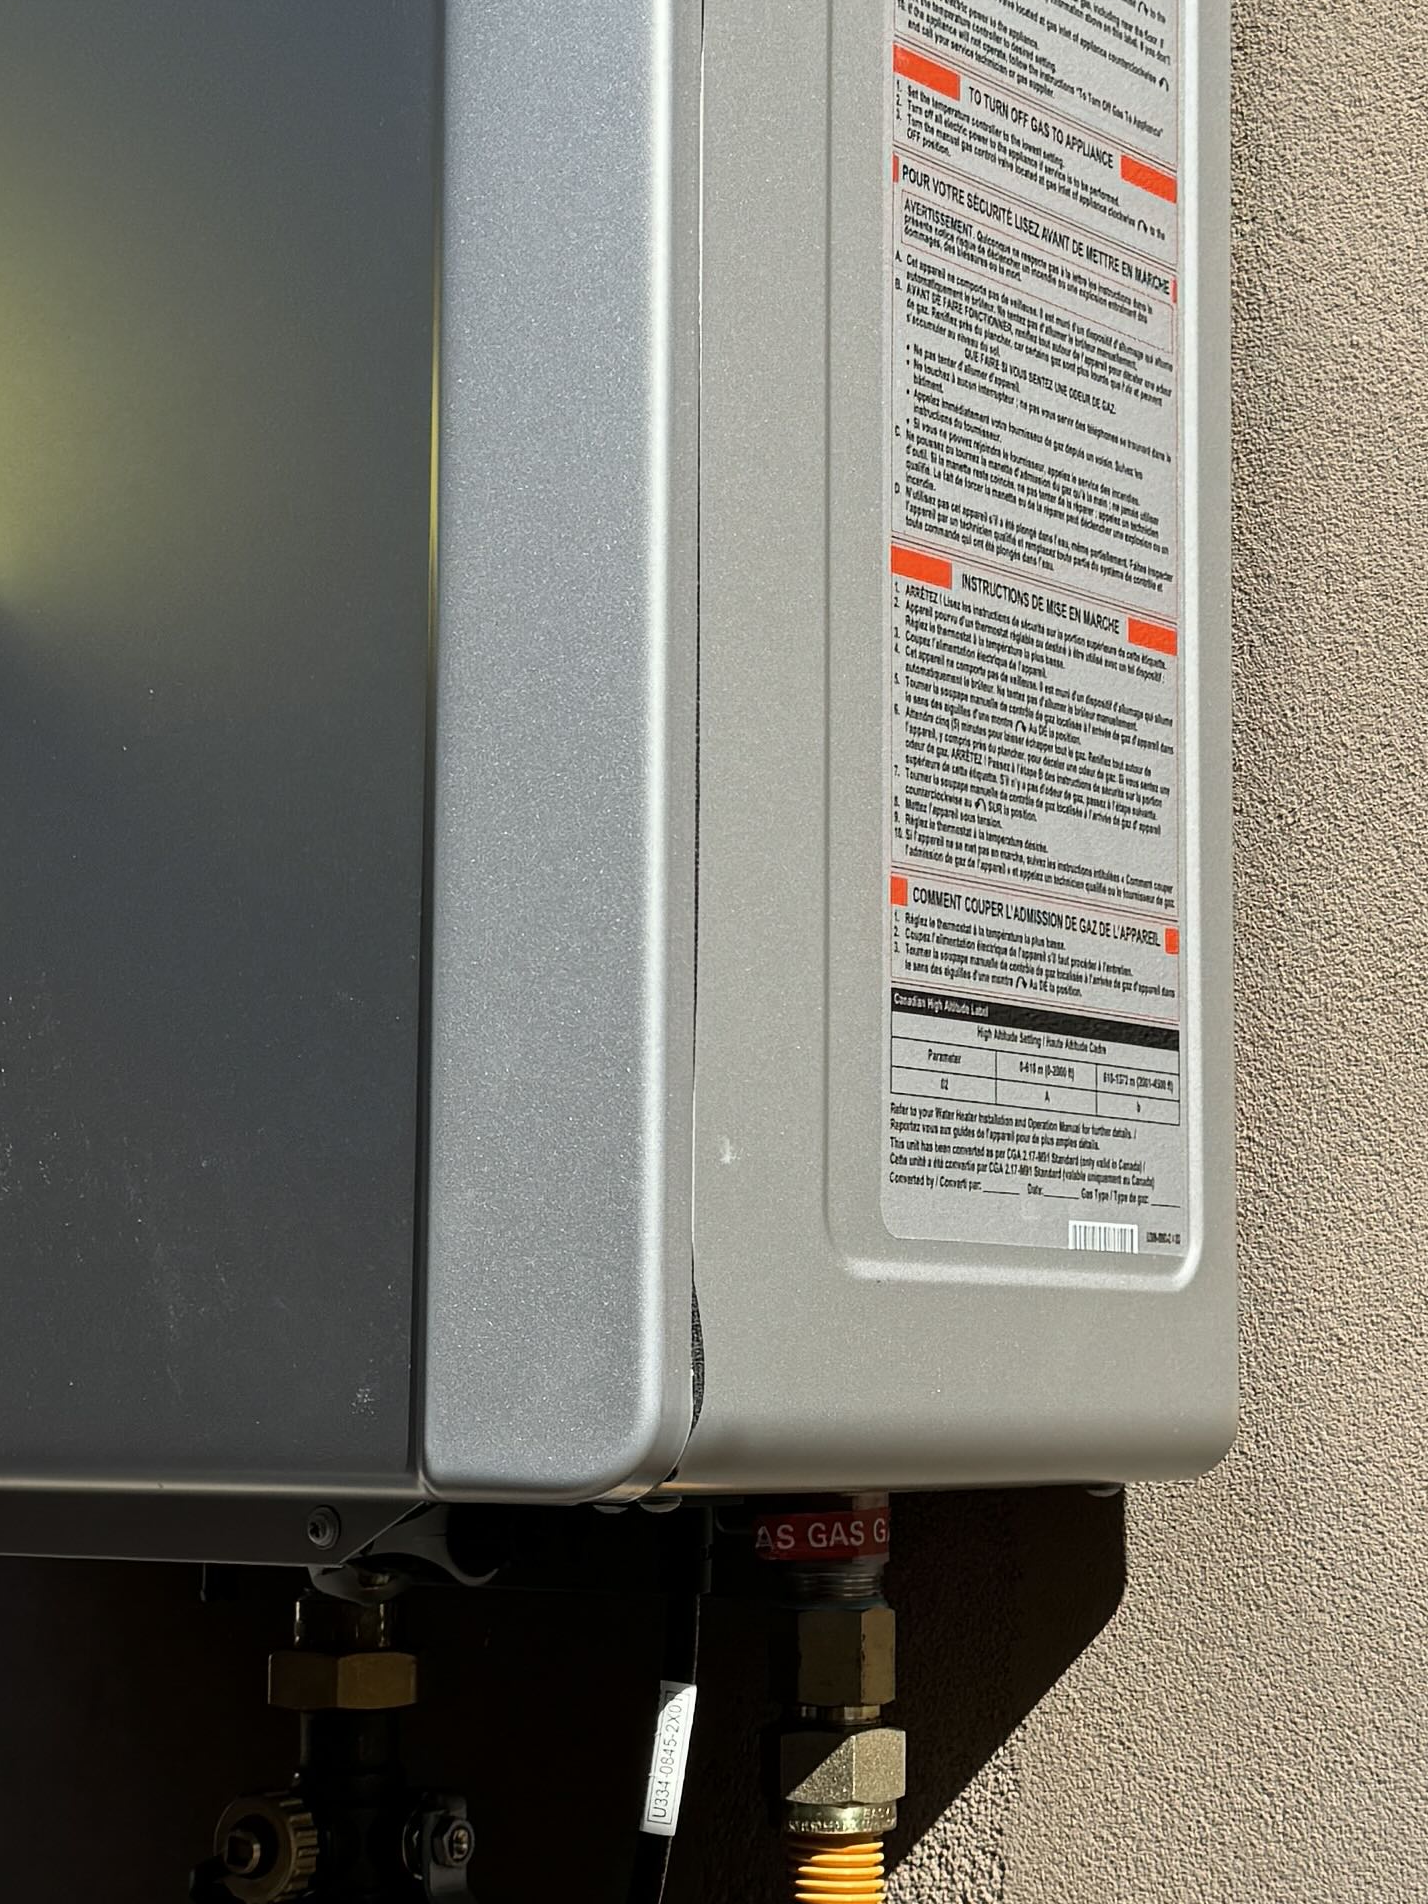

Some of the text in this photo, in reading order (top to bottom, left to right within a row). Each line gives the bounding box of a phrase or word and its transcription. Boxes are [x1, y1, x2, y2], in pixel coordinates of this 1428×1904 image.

[969, 86, 1114, 170] TO TURN OFF GAS TO APPLIANCE
[902, 163, 1171, 296] POUR VOTRE SÉCURITÉ LISEZ AVANT DE METTRE EN MARCHE
[964, 347, 979, 365] QUE
[980, 352, 1001, 371] FAIRE
[1009, 363, 1028, 382] VOUS
[1028, 372, 1054, 392] SENTEZ
[1054, 381, 1068, 397] UNE
[1069, 386, 1092, 407] ODEUR
[1091, 395, 1102, 410] DE
[962, 573, 1121, 635] INSTRUCTIONS DE MISE EN MARCHE
[913, 886, 963, 911] COMMENT
[964, 897, 1005, 920] COUPER
[1005, 904, 1064, 930] L'ADMISSION
[1065, 916, 1079, 932] DE
[1079, 919, 1098, 935] GAZ
[1099, 923, 1113, 939] DE
[893, 992, 990, 1018] Canadian High Altitude Label
[977, 1026, 993, 1042] High
[928, 1048, 962, 1065] Parameter
[890, 1101, 909, 1118] Refer
[917, 1107, 934, 1122] your
[955, 1109, 978, 1125] Heater
[1027, 1117, 1058, 1134] Operation
[889, 1172, 924, 1188] Converted
[807, 1520, 865, 1548] GAS
